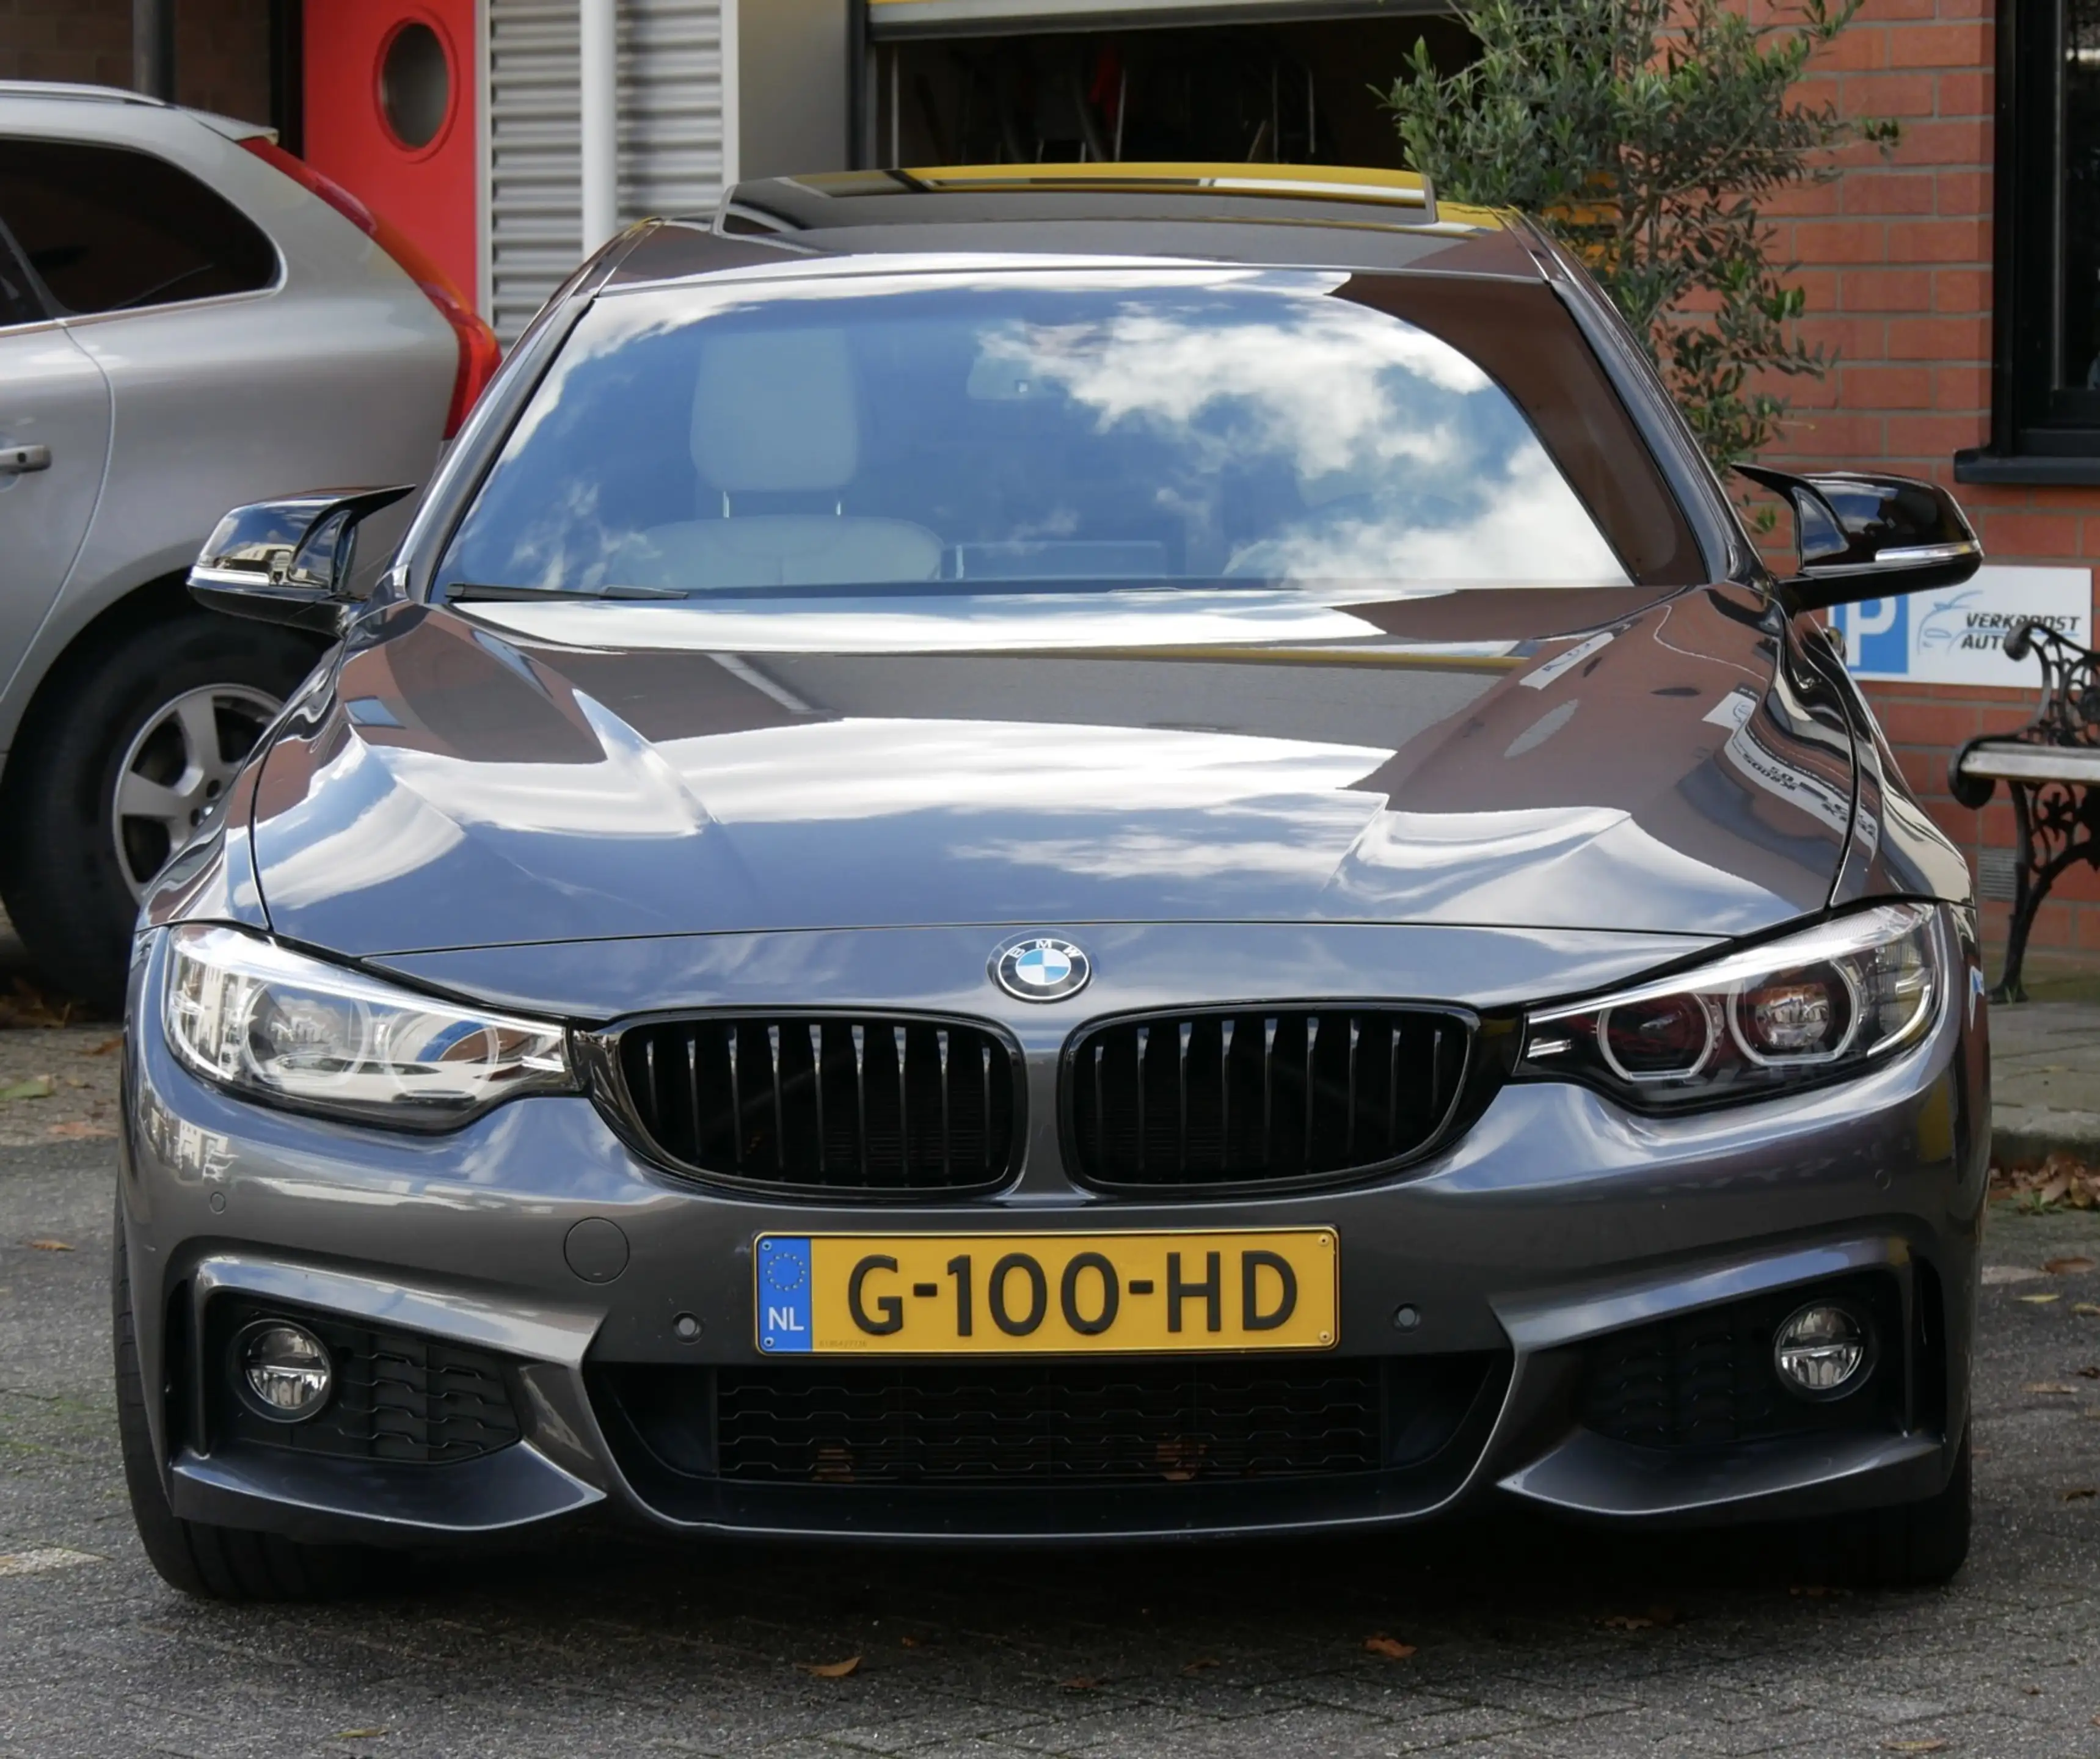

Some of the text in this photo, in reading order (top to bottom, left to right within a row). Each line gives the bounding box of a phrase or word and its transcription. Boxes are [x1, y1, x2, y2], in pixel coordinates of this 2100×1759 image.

[1846, 595, 1897, 666] P
[1961, 634, 2004, 650] AUT
[1008, 939, 1081, 958] BMW
[847, 1250, 1298, 1337] G-100-HD
[768, 1306, 804, 1331] NL
